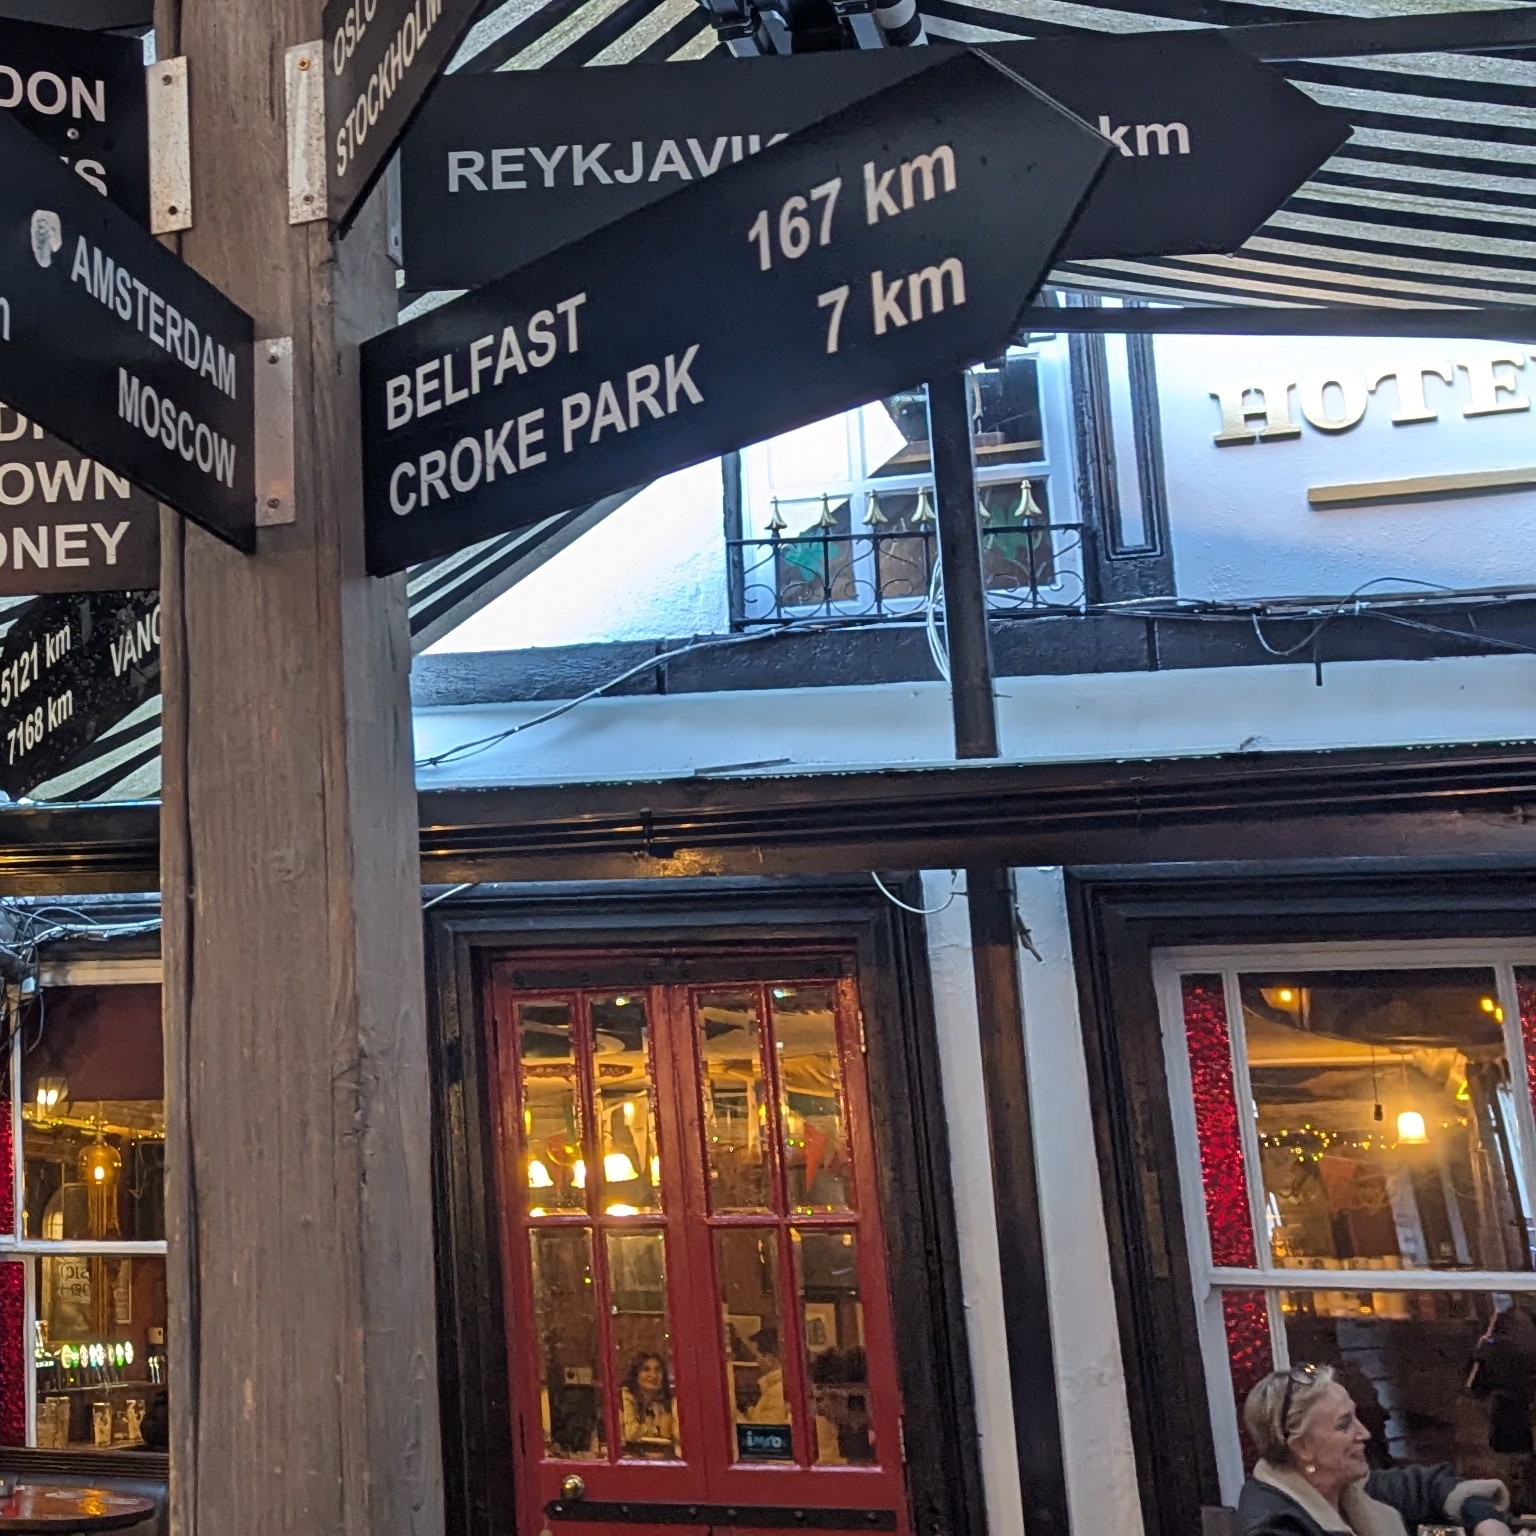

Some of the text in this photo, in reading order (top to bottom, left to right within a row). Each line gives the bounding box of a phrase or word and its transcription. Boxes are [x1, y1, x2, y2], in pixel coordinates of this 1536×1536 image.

[447, 115, 1191, 194] REYKJAVI km
[70, 235, 236, 400] AMSTERDAM
[383, 142, 957, 431] BELFAST 167 km
[117, 366, 236, 488] MOSCOW
[387, 252, 967, 517] CROKE PARK 7 km
[1209, 350, 1536, 448] HOTE
[0, 641, 40, 708] 5121
[45, 624, 72, 669] km
[6, 689, 74, 766] 7168 km
